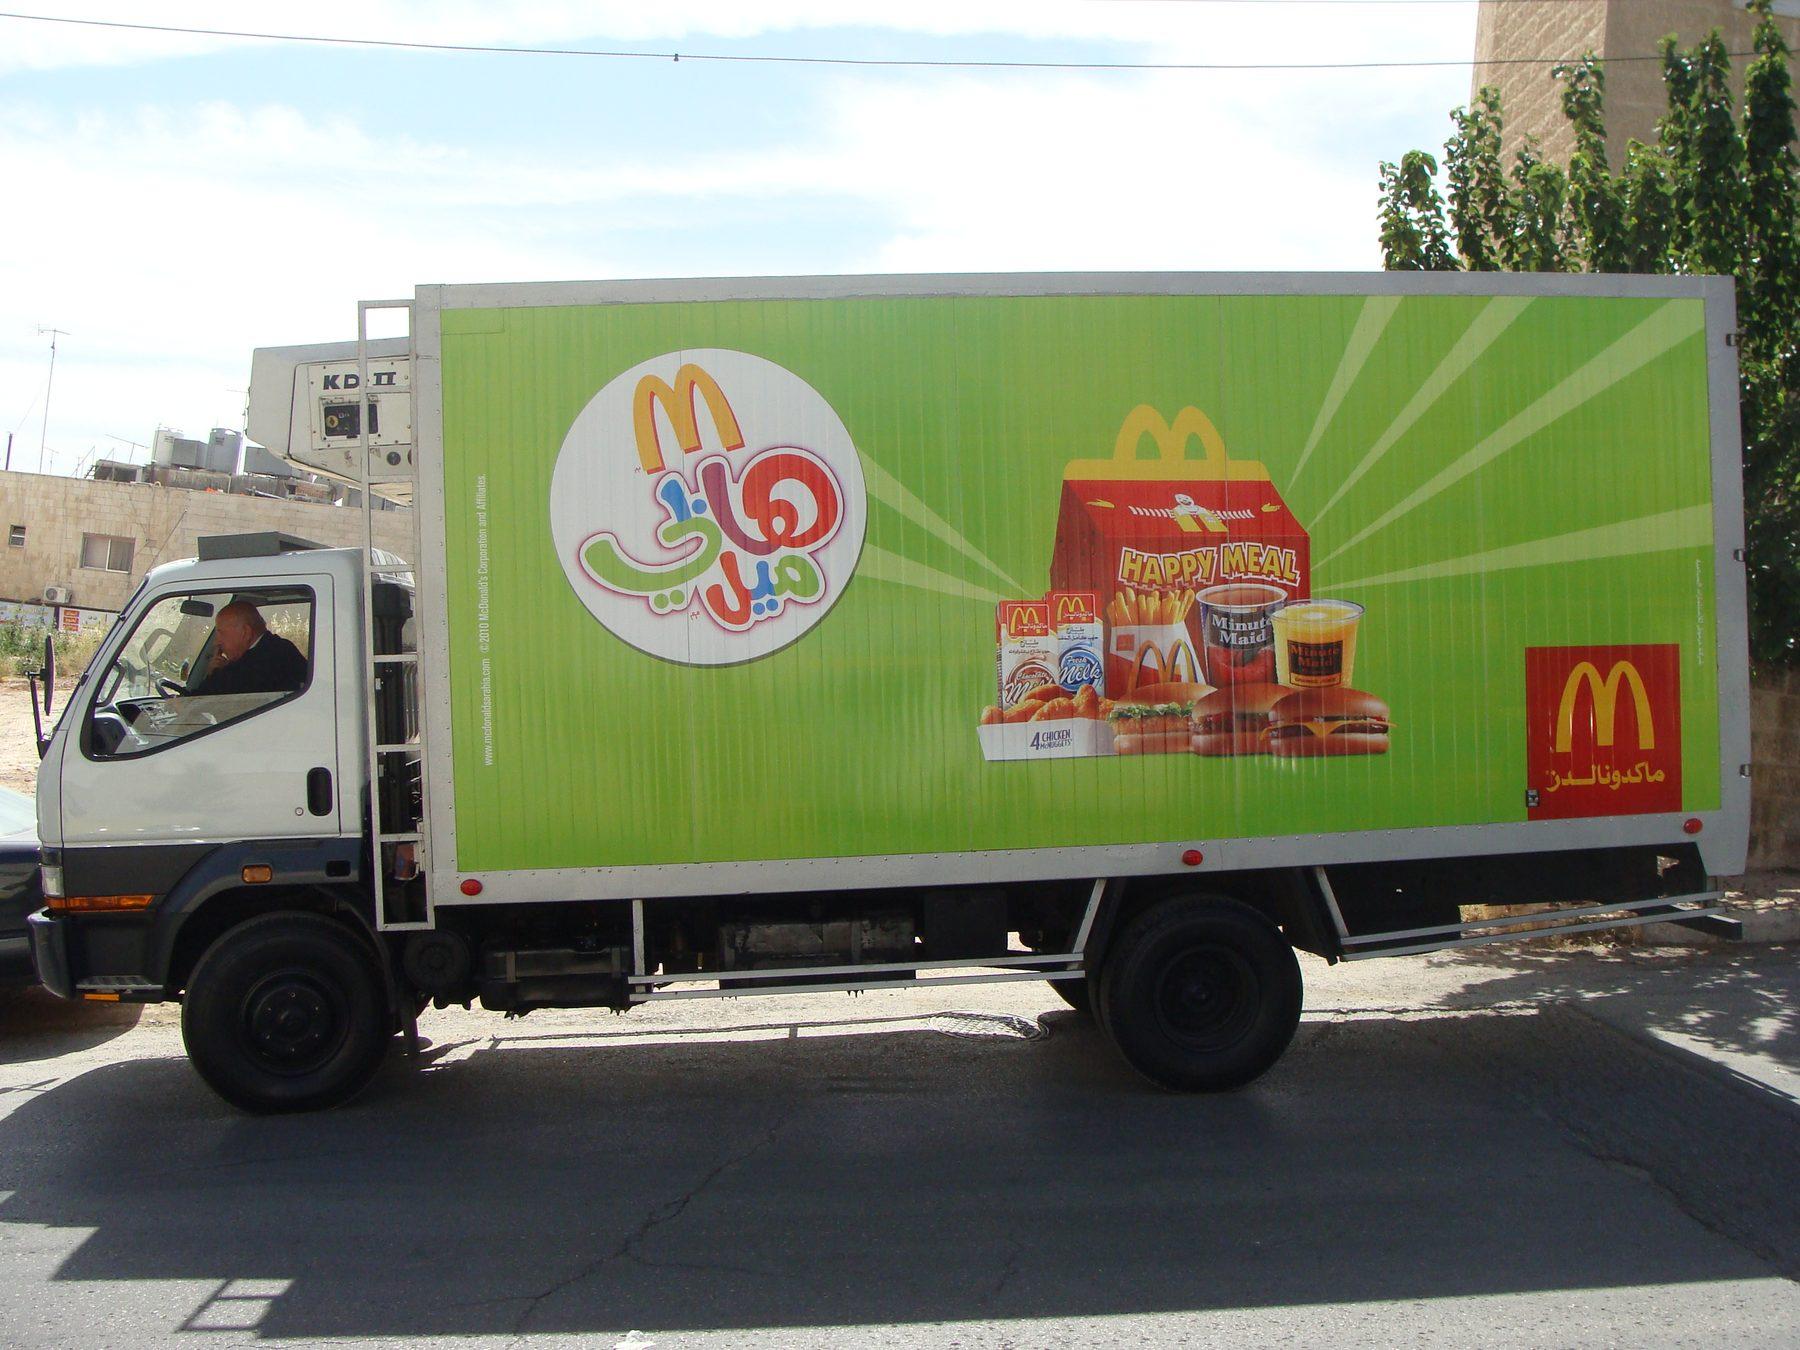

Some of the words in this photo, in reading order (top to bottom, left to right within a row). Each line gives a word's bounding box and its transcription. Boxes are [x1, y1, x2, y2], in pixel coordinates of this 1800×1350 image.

[475, 473, 487, 510] Affiliates.
[476, 512, 487, 527] and
[476, 529, 490, 574] Corporation
[1119, 547, 1218, 588] HAPPY
[1220, 542, 1300, 586] MEAL
[477, 576, 489, 621] McDonald's
[706, 550, 820, 625] ميل
[1219, 630, 1267, 645] Maid
[1060, 661, 1101, 683] Milk
[481, 658, 493, 766] www.mcdonaldsarabia.com
[1030, 732, 1040, 750] 4
[1042, 729, 1071, 742] CHICKEN
[1546, 761, 1665, 792] ماكدونالدز
